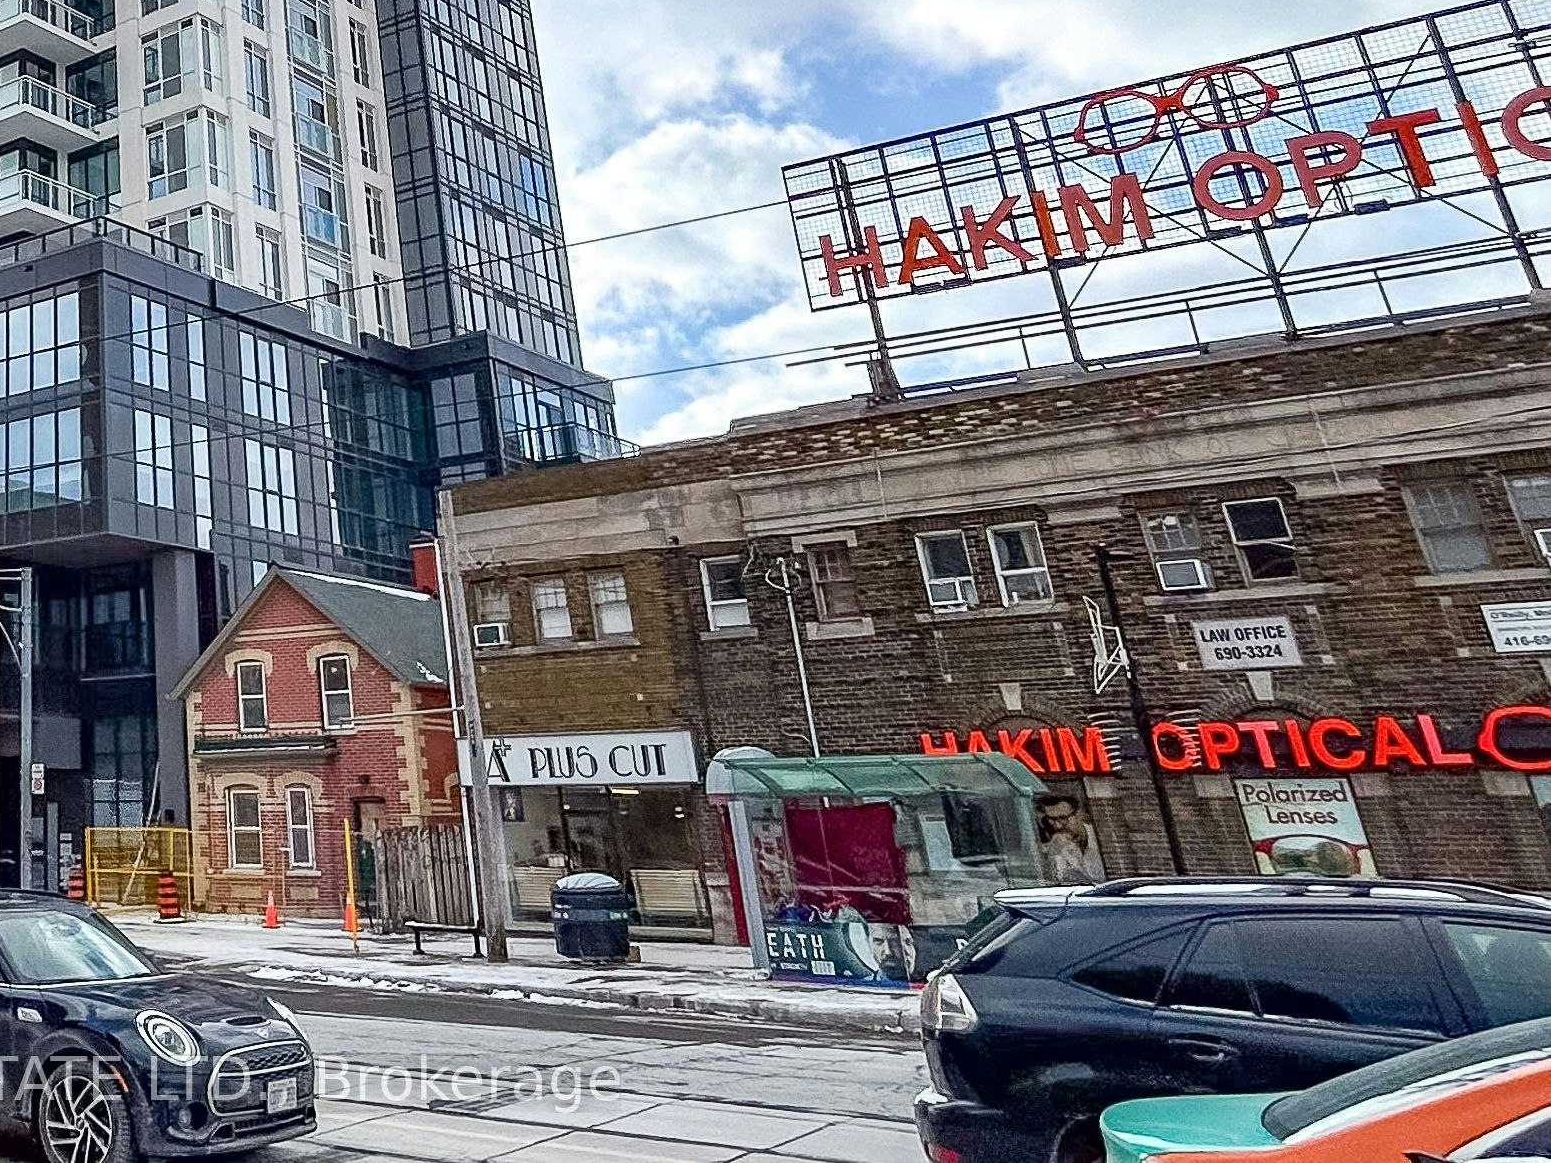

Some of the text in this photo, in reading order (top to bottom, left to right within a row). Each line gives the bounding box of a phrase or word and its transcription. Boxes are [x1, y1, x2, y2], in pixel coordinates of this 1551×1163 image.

[819, 85, 1551, 297] HAKIM OPTIC
[1199, 624, 1287, 644] LAW OFFICE
[1214, 643, 1284, 661] 690-3324
[920, 712, 1476, 774] HAKIM OPTICAL
[527, 744, 599, 779] PLUS
[608, 742, 667, 777] CUT
[1241, 780, 1349, 803] Polarized
[1264, 803, 1339, 825] Lenses
[766, 932, 826, 960] EATH
